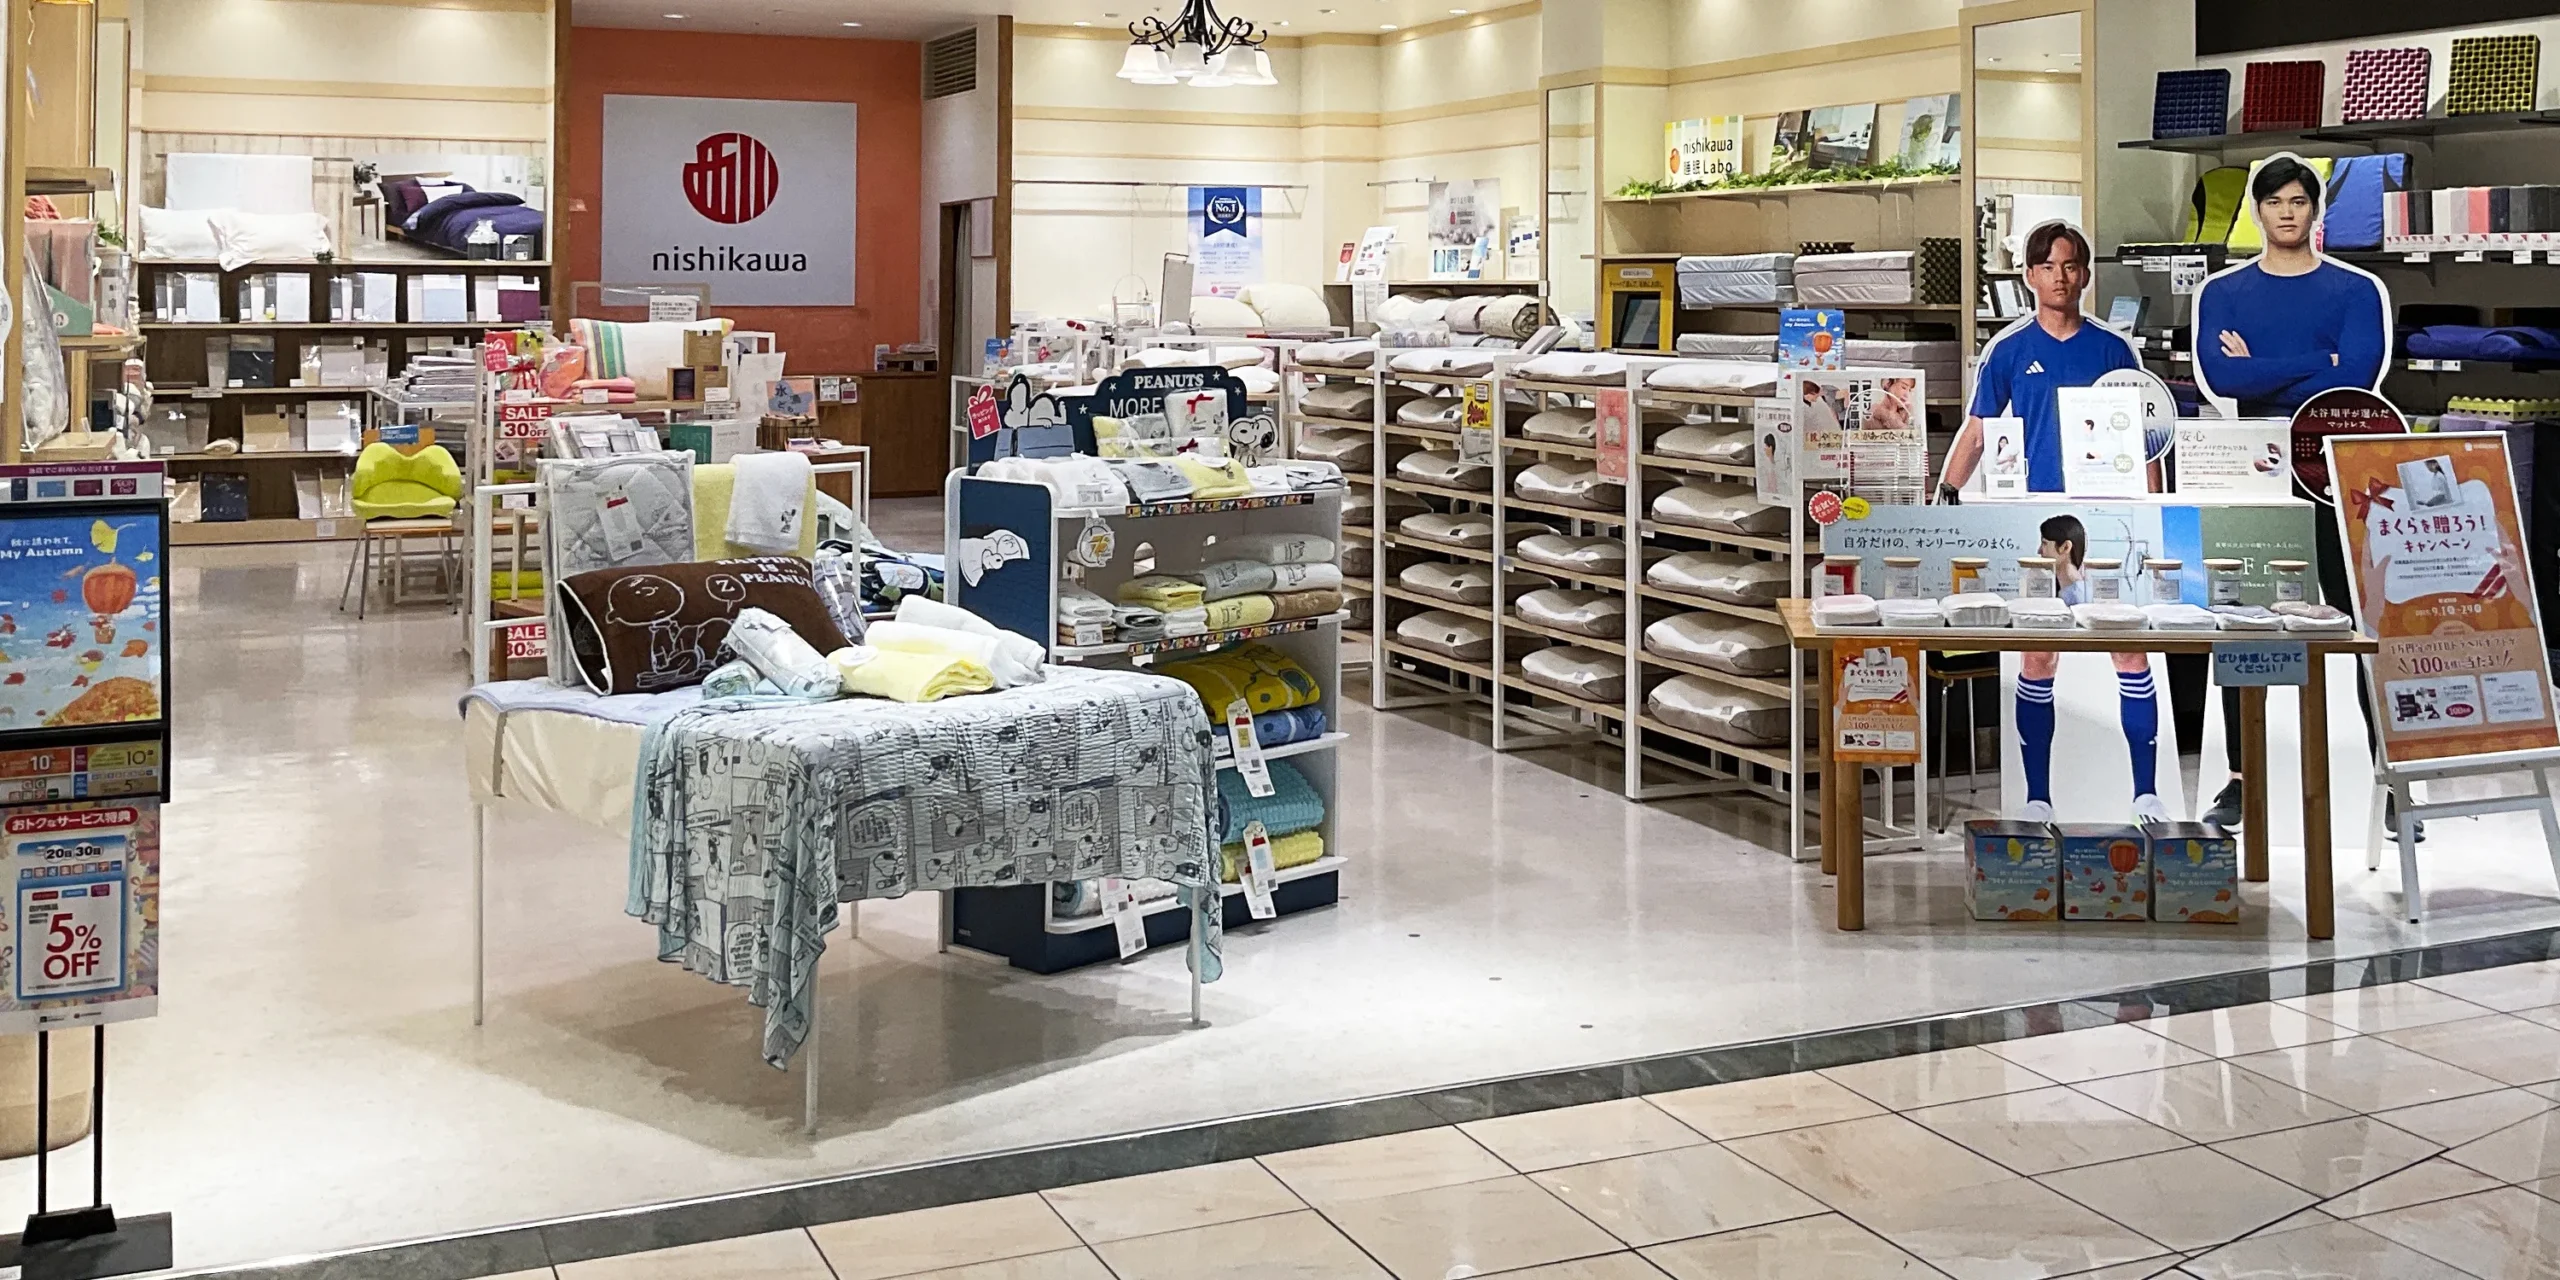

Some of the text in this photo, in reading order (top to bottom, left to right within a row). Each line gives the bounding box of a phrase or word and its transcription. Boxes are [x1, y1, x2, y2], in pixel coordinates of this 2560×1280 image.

[1684, 137, 1733, 154] nishikawa
[1703, 159, 1733, 174] Labo
[1215, 204, 1236, 213] No.1
[653, 246, 807, 272] nishikawa
[1134, 374, 1204, 389] PEANUTS
[505, 407, 547, 420] SALE
[2308, 408, 2390, 419] 大谷翔平が選んだ
[2180, 430, 2207, 442] 安心
[1844, 537, 2020, 550] 自分だけの、オンリーワンのまくら。
[2404, 537, 2471, 553] キャンペーン
[0, 547, 84, 560] My Autumn
[716, 580, 735, 592] Z
[2218, 652, 2303, 663] ぜひ体感してみて
[12, 810, 131, 831] おトクなサービス特典
[46, 913, 102, 953] 5%
[43, 952, 100, 980] OFF
